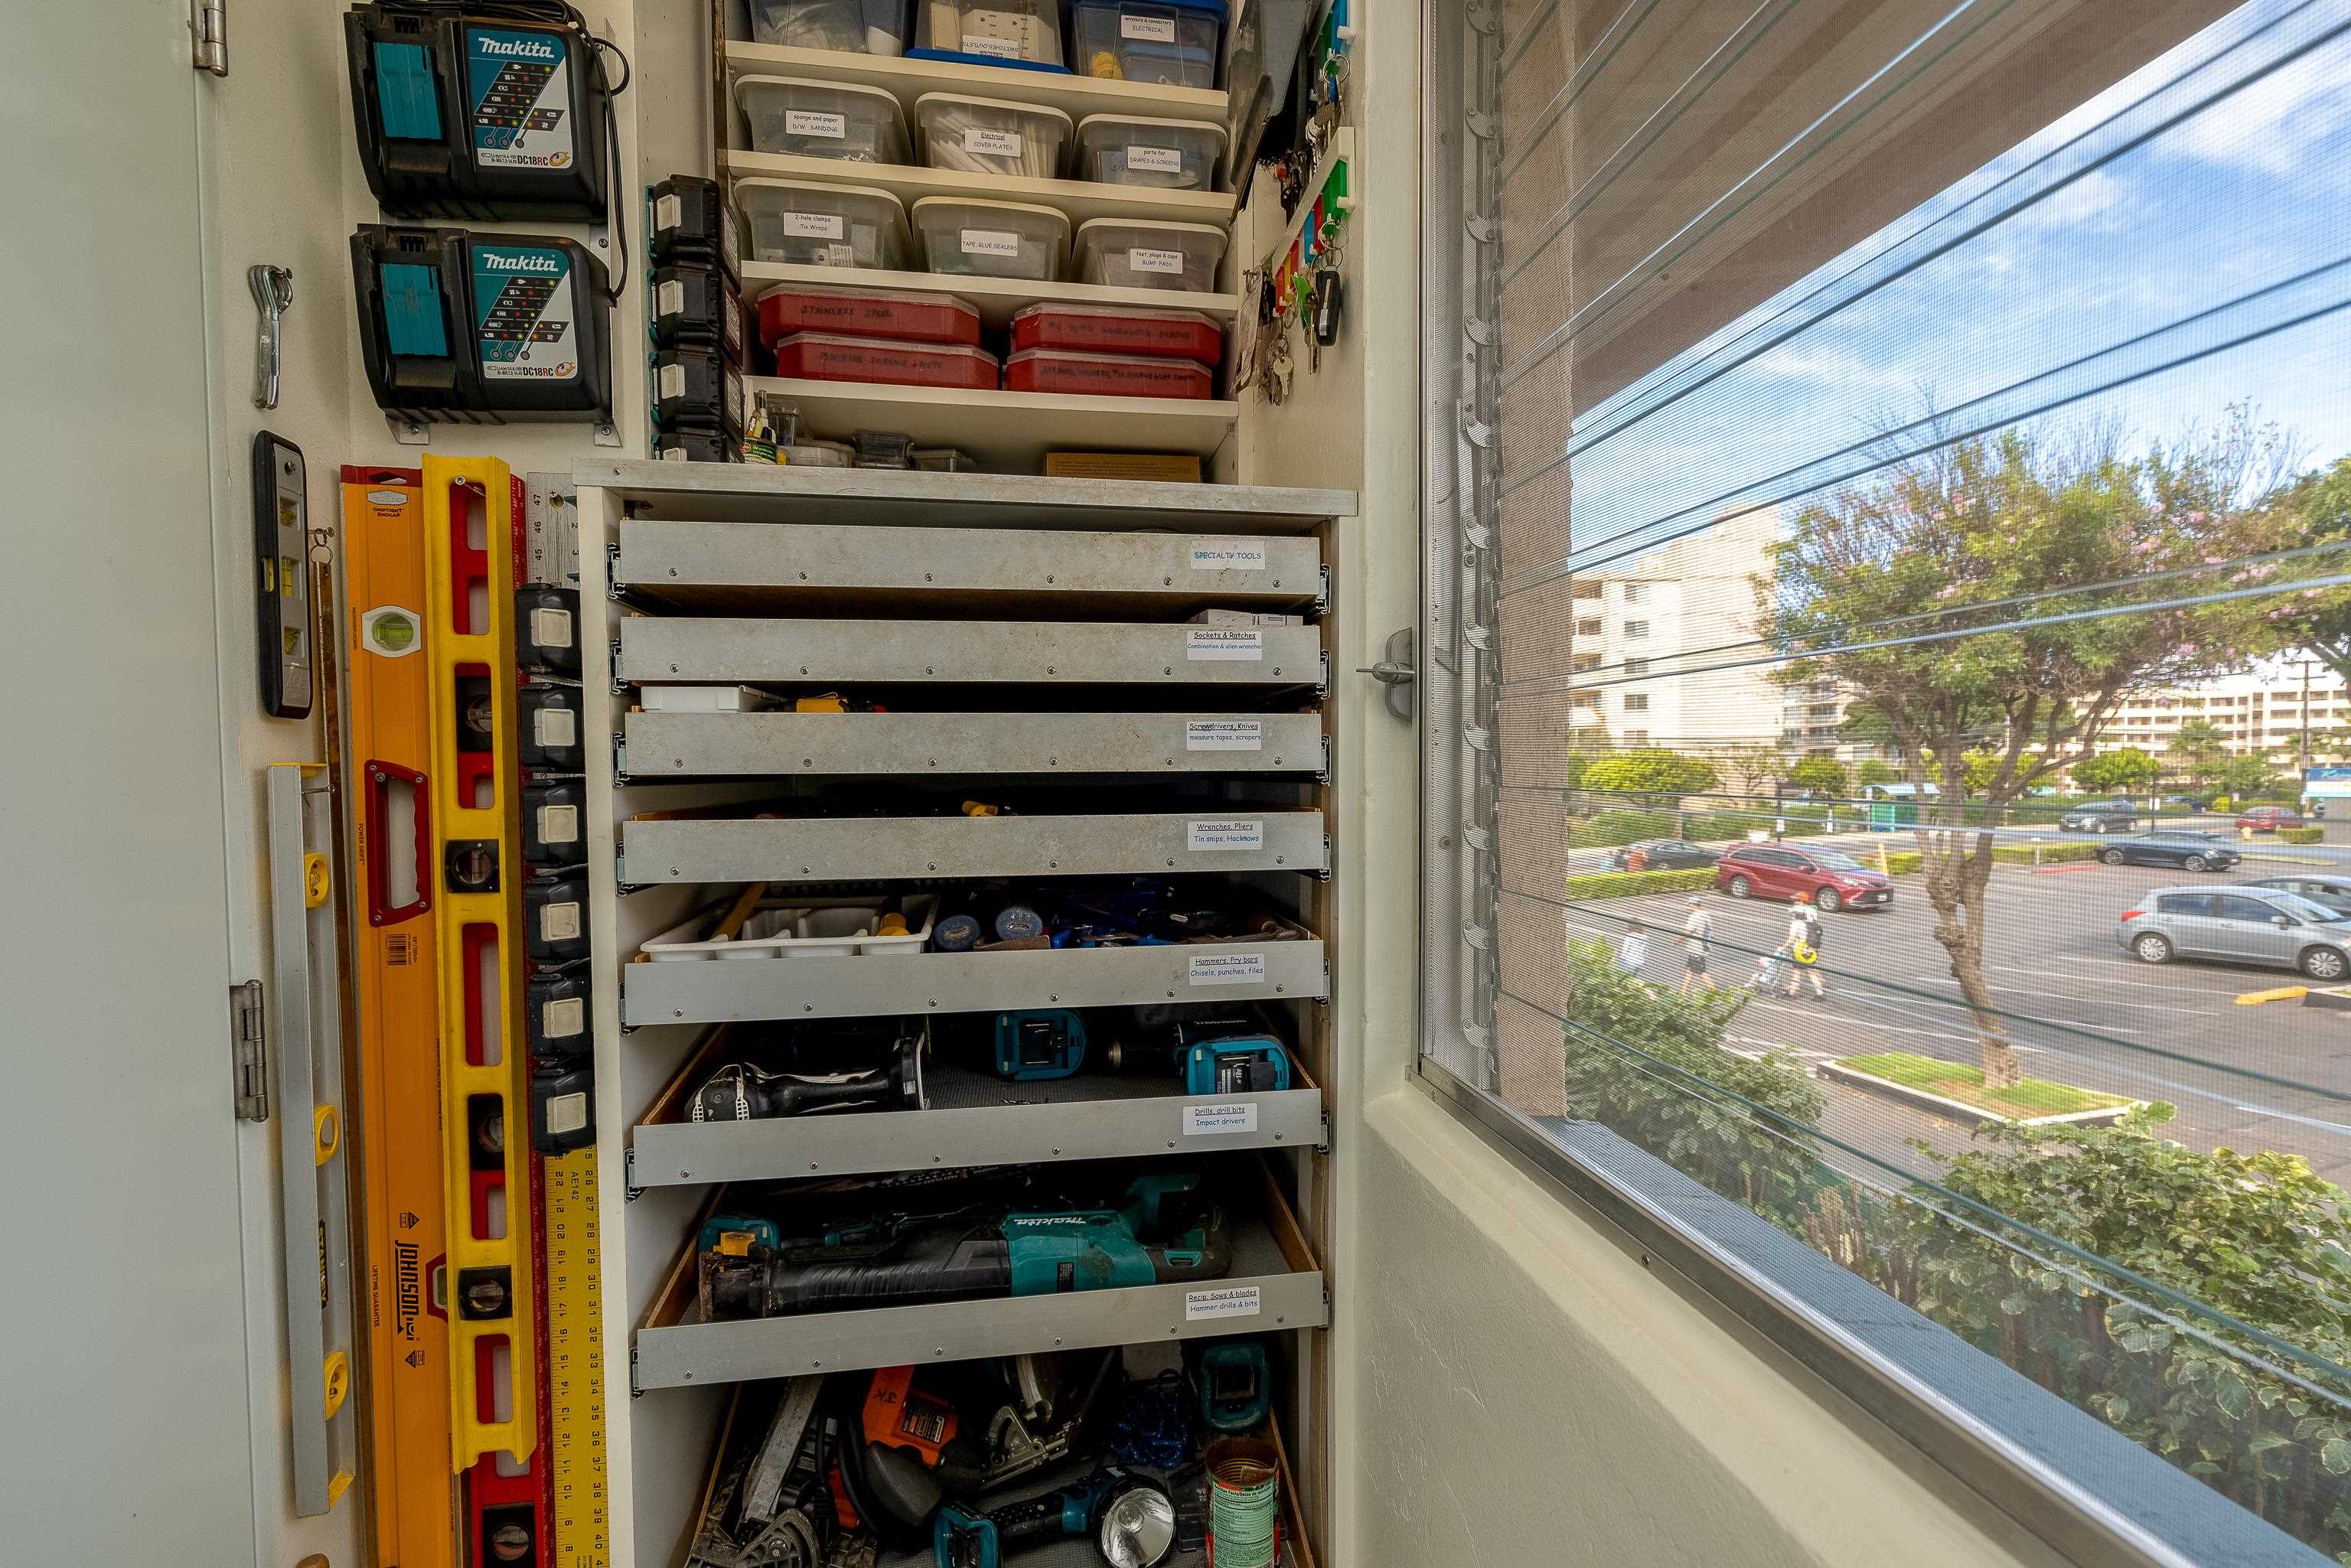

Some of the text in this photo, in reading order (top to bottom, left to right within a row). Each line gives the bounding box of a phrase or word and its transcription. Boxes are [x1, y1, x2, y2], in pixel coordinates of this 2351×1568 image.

[478, 37, 555, 58] Makita
[980, 132, 1005, 141] Electrical
[517, 155, 548, 165] DC18RC
[483, 253, 559, 272] Makita
[523, 367, 553, 377] DC18RC
[533, 494, 541, 506] 47
[534, 521, 542, 533] 46
[535, 549, 542, 561] 45
[1189, 723, 1236, 732] Screwdrivers,
[1234, 823, 1254, 831] Pliers
[1218, 968, 1247, 976] punches,
[1195, 1107, 1215, 1116] Drills,
[555, 1171, 564, 1187] 22
[585, 1170, 594, 1185] 26
[571, 1171, 579, 1200] AE142
[556, 1198, 564, 1213] 21
[586, 1196, 594, 1211] 27
[556, 1224, 565, 1239] 20
[587, 1222, 595, 1237] 28
[558, 1250, 566, 1264] 19
[588, 1249, 595, 1264] 29
[395, 1240, 419, 1315] JOHNSON
[558, 1276, 566, 1291] 18
[588, 1275, 595, 1290] 30
[559, 1303, 567, 1317] 17
[589, 1301, 596, 1315] 31
[560, 1328, 568, 1344] 16
[589, 1327, 597, 1342] 32
[561, 1354, 569, 1369] 15
[590, 1353, 598, 1368] 33
[562, 1381, 569, 1396] 14
[591, 1379, 598, 1394] 34
[562, 1407, 569, 1422] 13
[591, 1405, 599, 1420] 35
[562, 1433, 570, 1448] 12
[592, 1431, 600, 1446] 36
[563, 1459, 571, 1474] 11
[592, 1456, 600, 1472] 37
[564, 1485, 572, 1499] 10
[593, 1482, 601, 1498] 38
[594, 1508, 602, 1524] 39
[595, 1534, 602, 1550] 40
